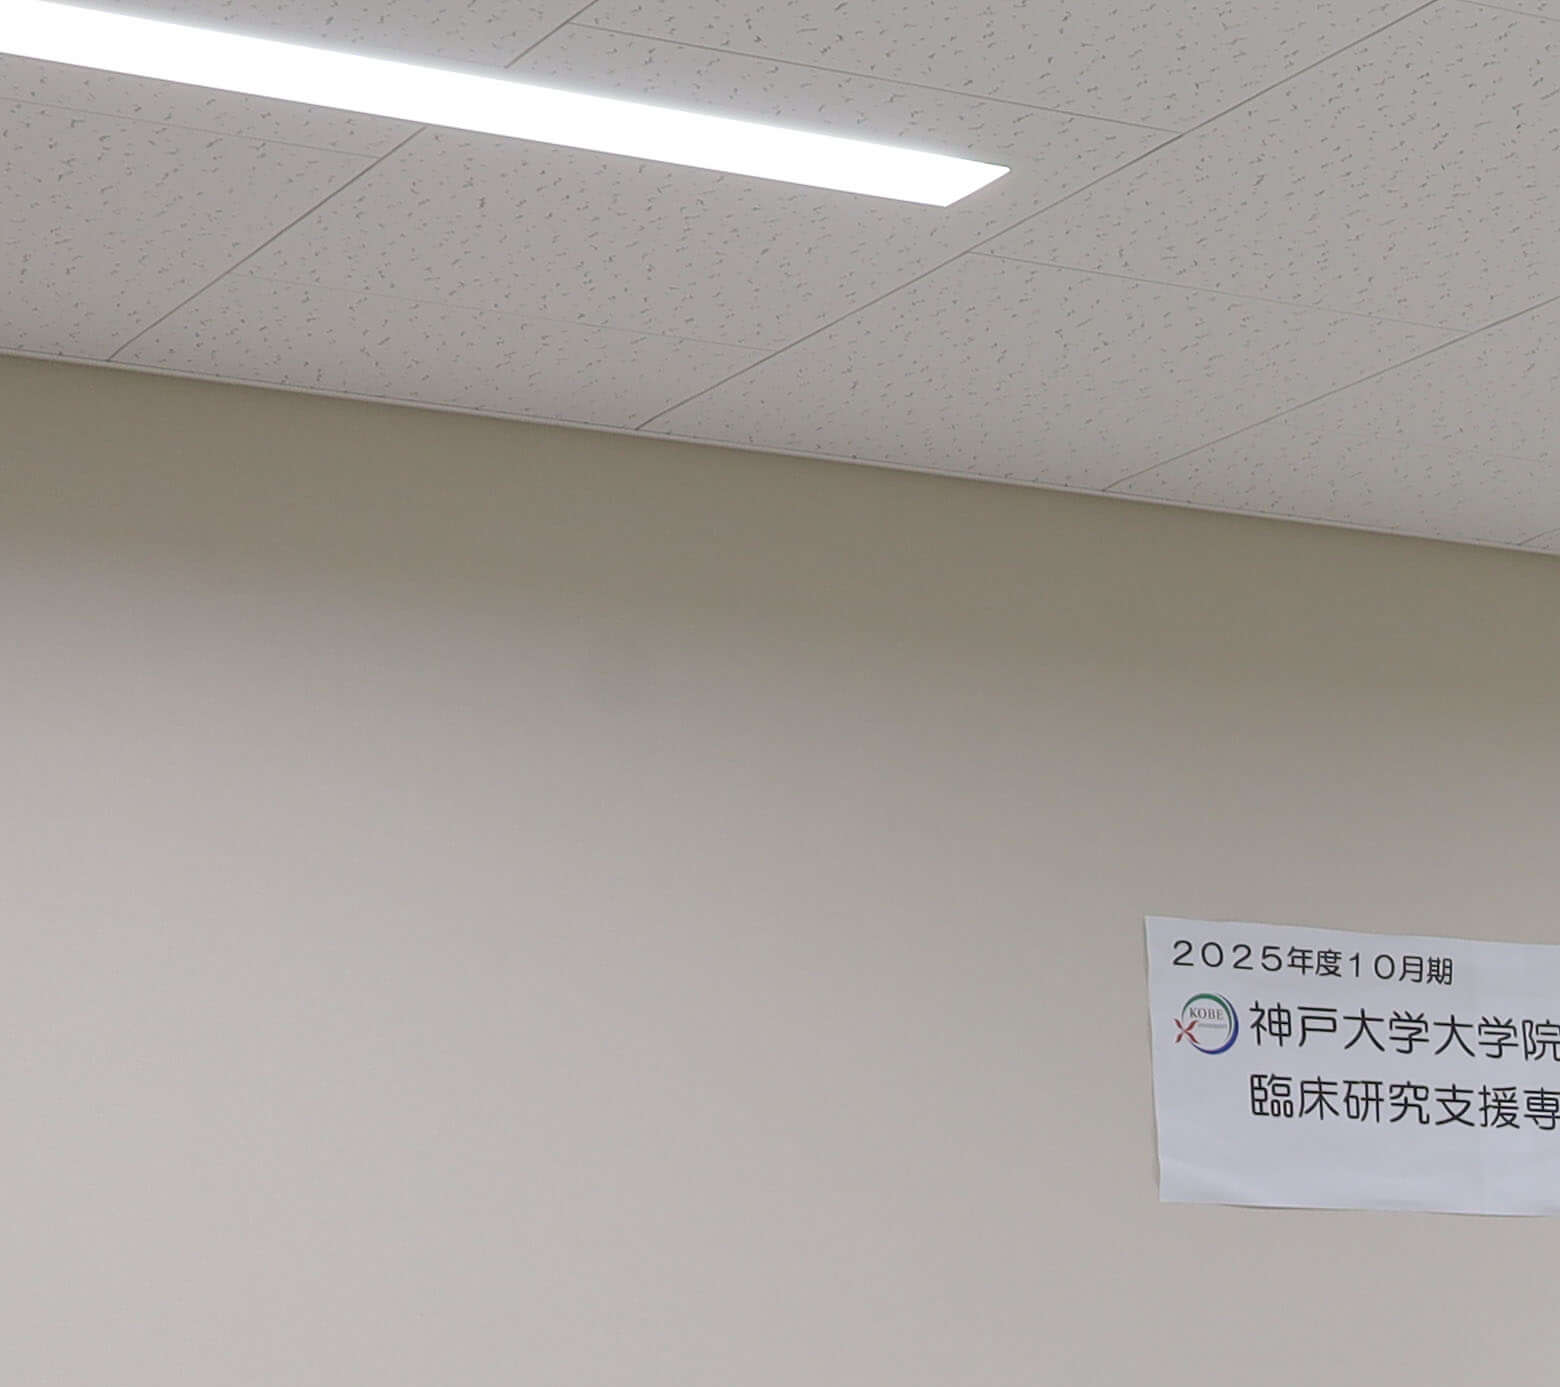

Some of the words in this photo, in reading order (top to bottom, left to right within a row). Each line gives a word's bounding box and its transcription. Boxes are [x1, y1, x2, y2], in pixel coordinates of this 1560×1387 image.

[1173, 940, 1453, 986] 2025年度10月期
[1189, 1007, 1224, 1020] KOBE
